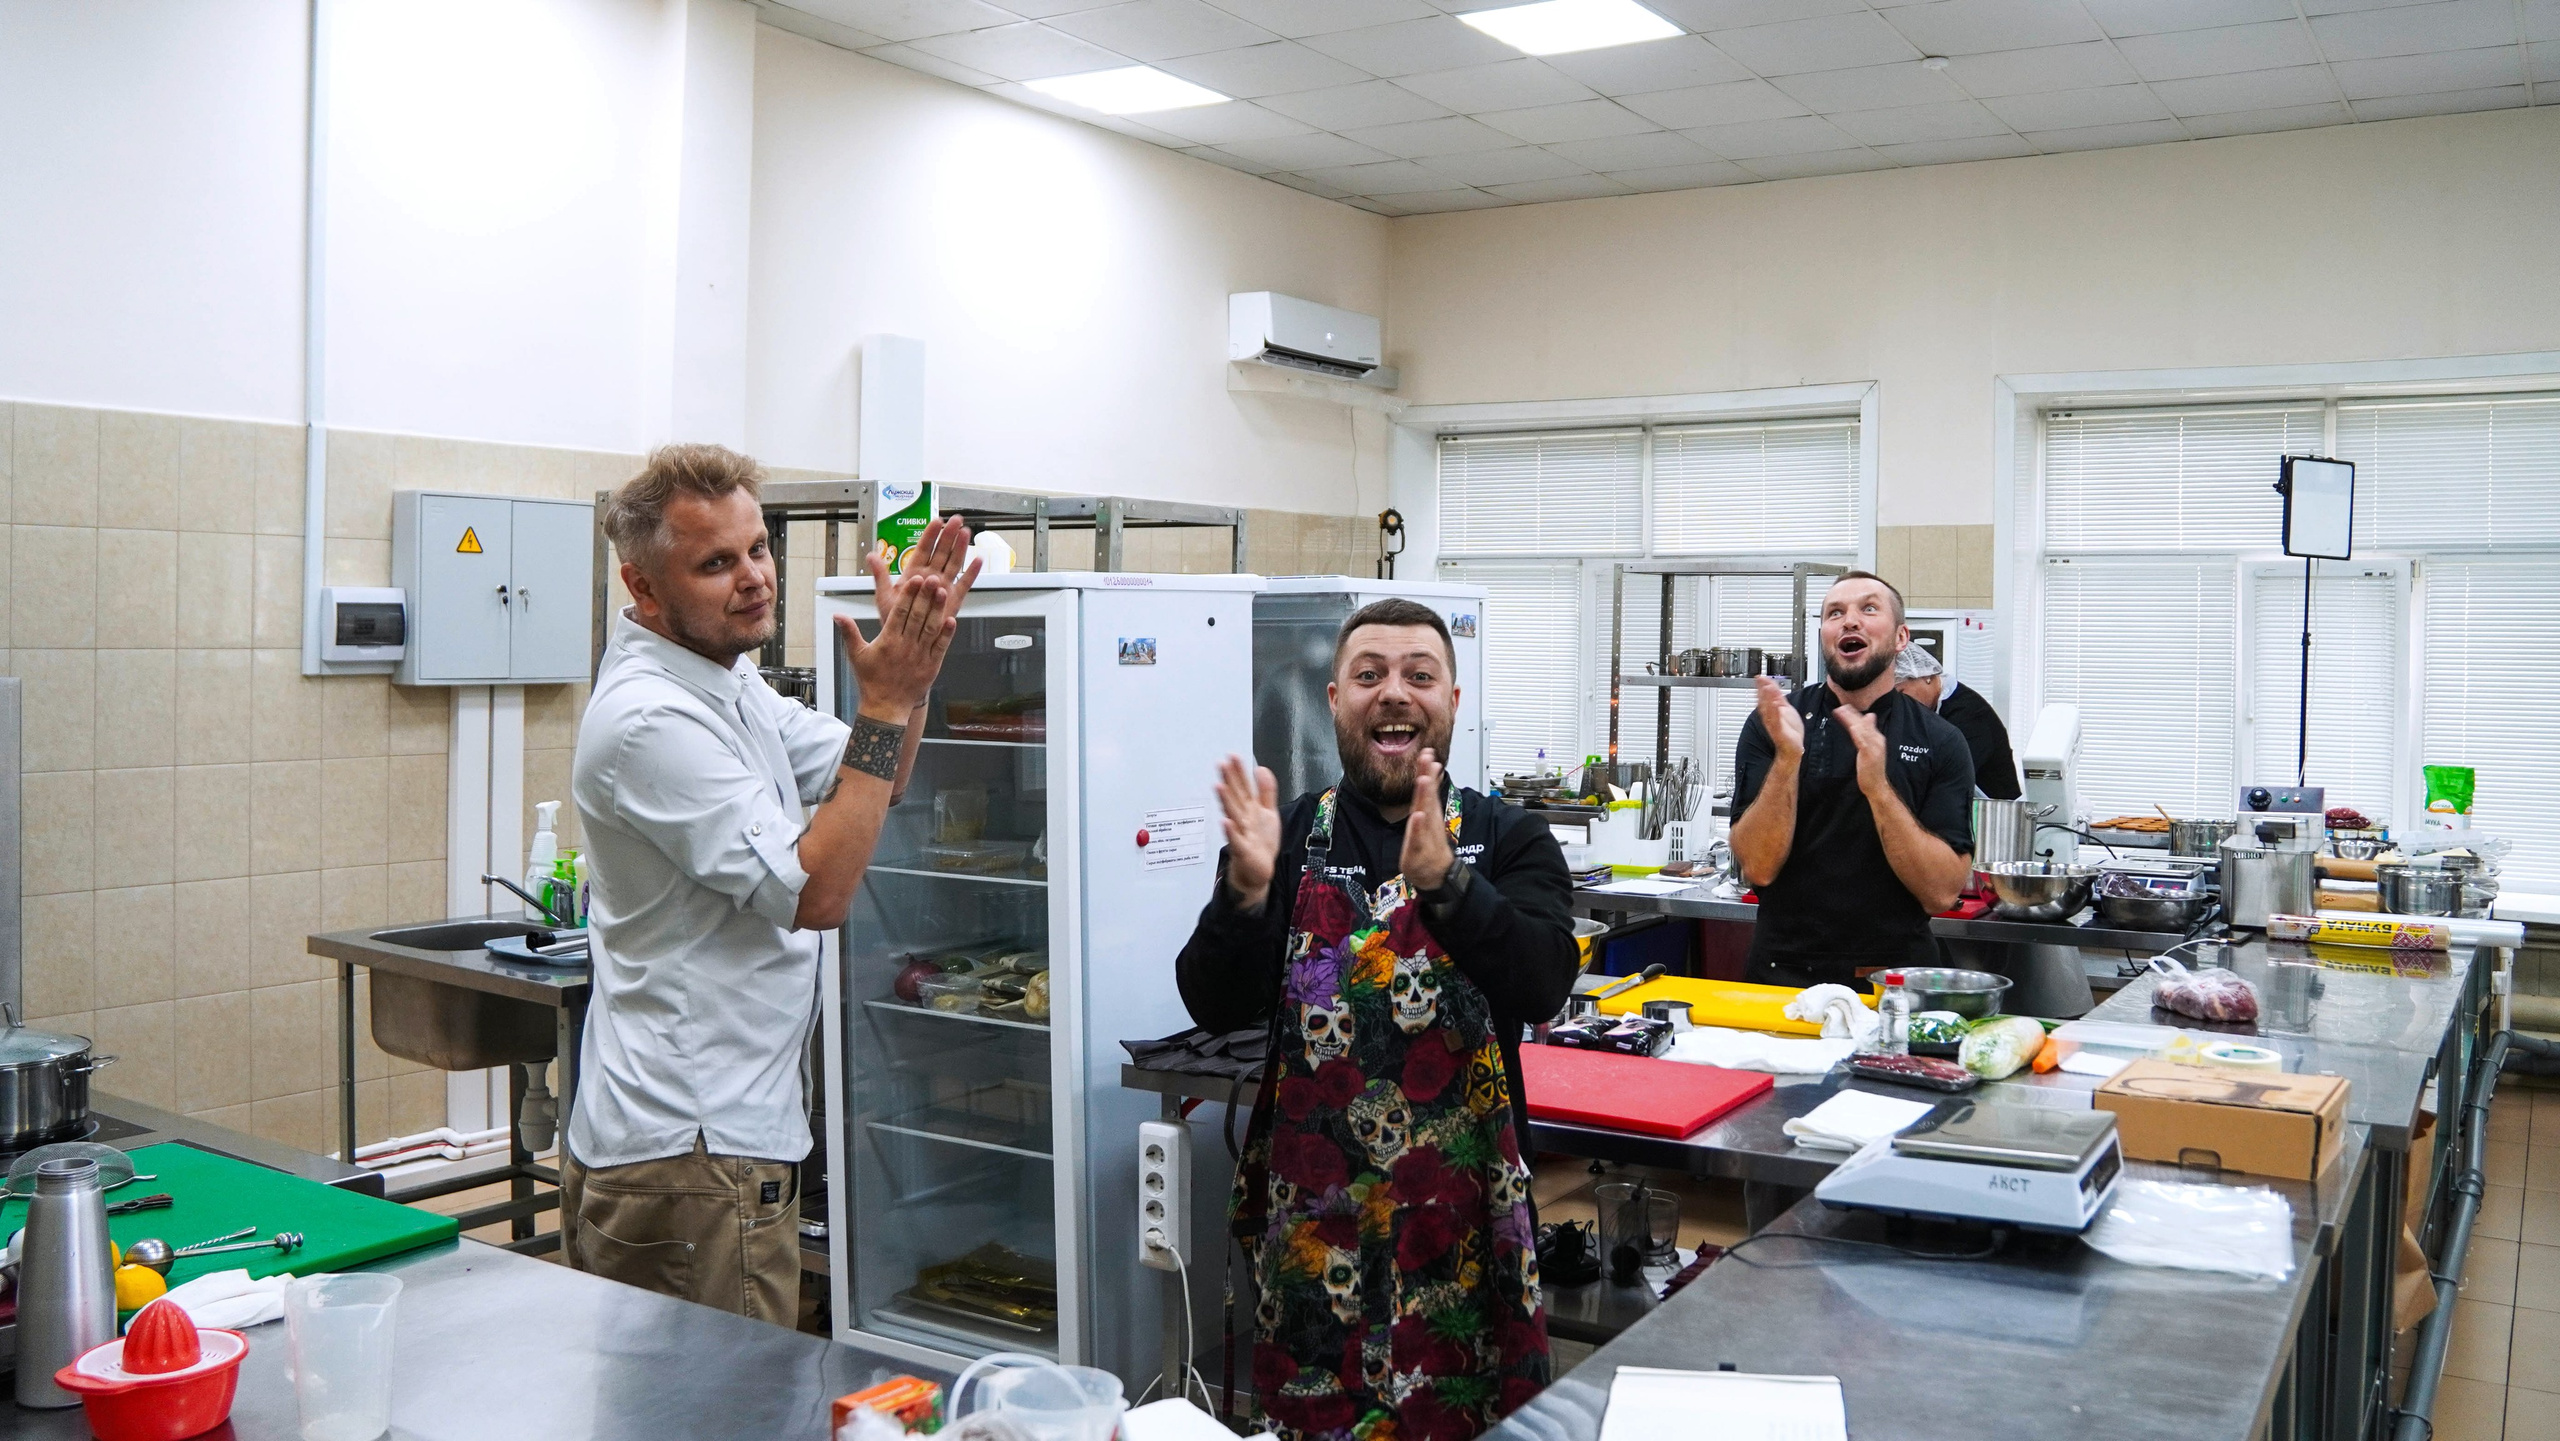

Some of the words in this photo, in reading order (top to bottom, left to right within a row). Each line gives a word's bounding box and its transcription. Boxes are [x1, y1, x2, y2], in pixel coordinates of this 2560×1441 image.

[1901, 752, 1919, 762] Petr
[1455, 844, 1485, 855] андр
[1339, 865, 1367, 876] TEAM
[2327, 920, 2392, 934] БУМАГА
